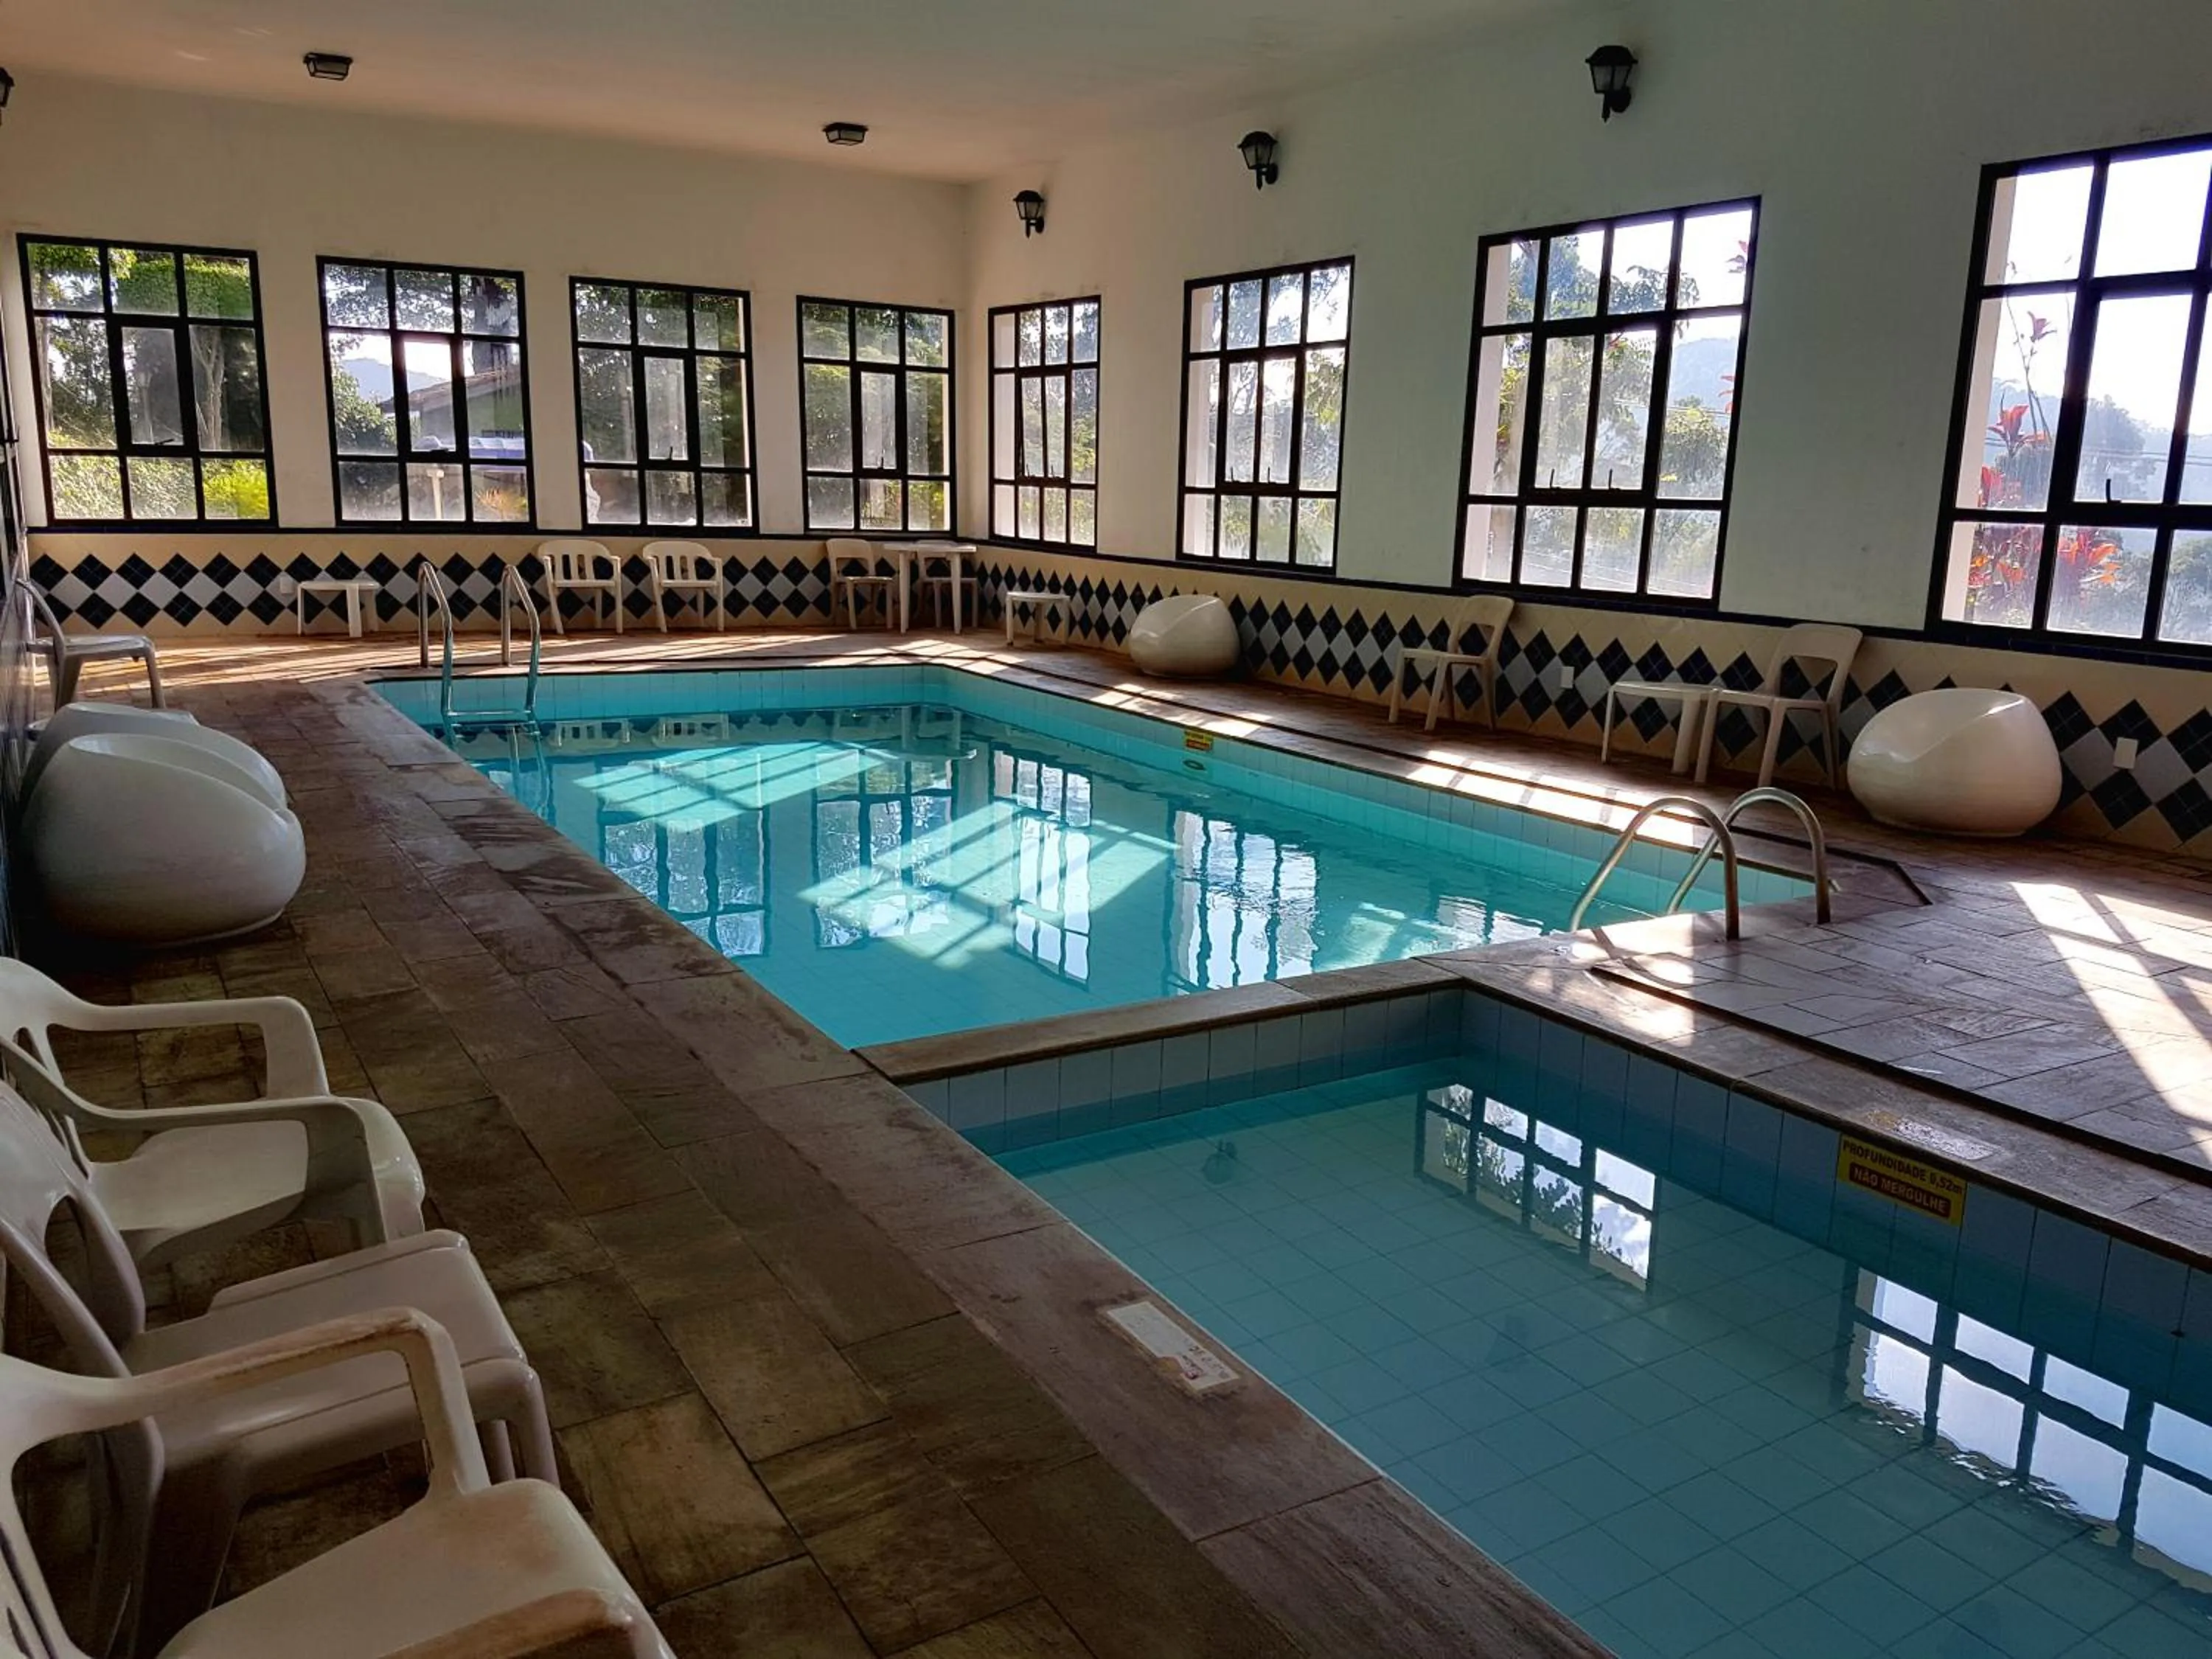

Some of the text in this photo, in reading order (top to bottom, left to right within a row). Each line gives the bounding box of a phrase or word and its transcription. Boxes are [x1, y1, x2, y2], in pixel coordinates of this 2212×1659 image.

[1843, 1140, 1926, 1182] PROFUNDIDADE
[1853, 1166, 1947, 1213] NÃO MERGULHE
